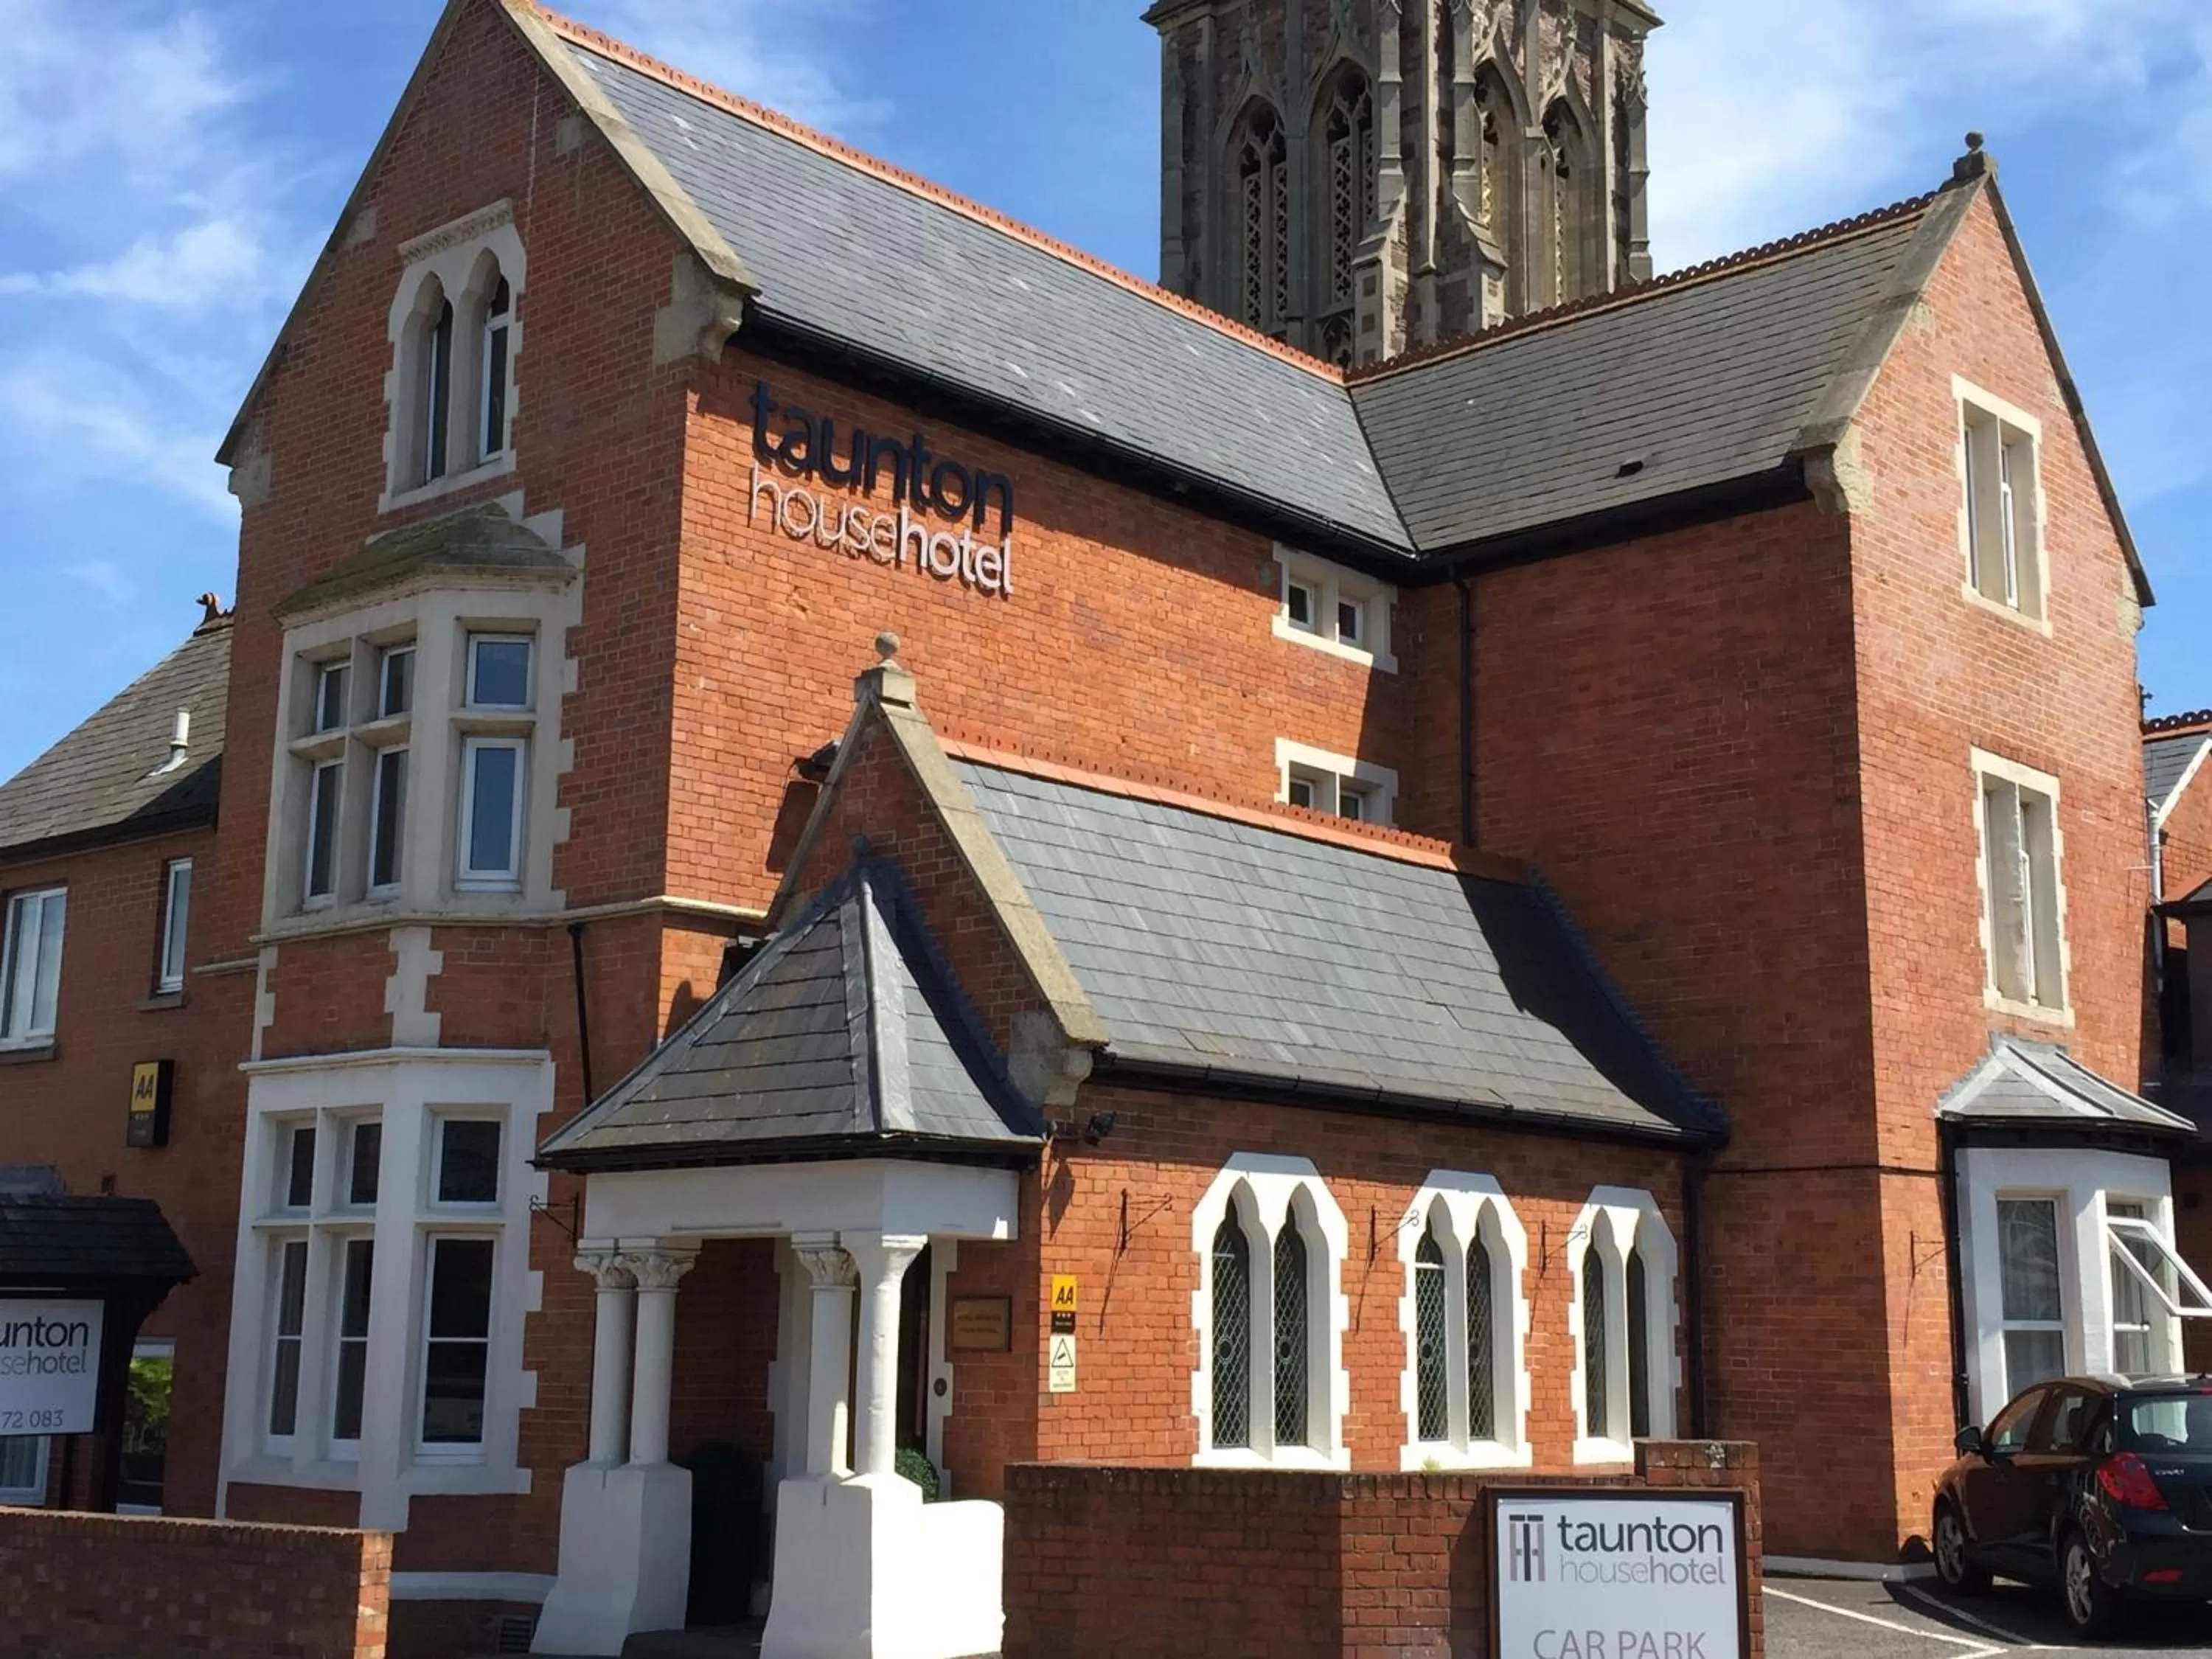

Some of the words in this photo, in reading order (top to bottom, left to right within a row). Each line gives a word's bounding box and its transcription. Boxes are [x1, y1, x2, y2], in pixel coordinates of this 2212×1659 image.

[749, 380, 1013, 535] taunton
[751, 461, 1014, 594] househotel
[135, 1074, 153, 1101] AA
[1056, 1285, 1074, 1304] AA
[29, 1409, 64, 1428] 083
[1557, 1514, 1722, 1553] taunton
[1559, 1554, 1726, 1584] househotel
[1533, 1629, 1605, 1659] CAR
[1618, 1631, 1706, 1659] PARK
